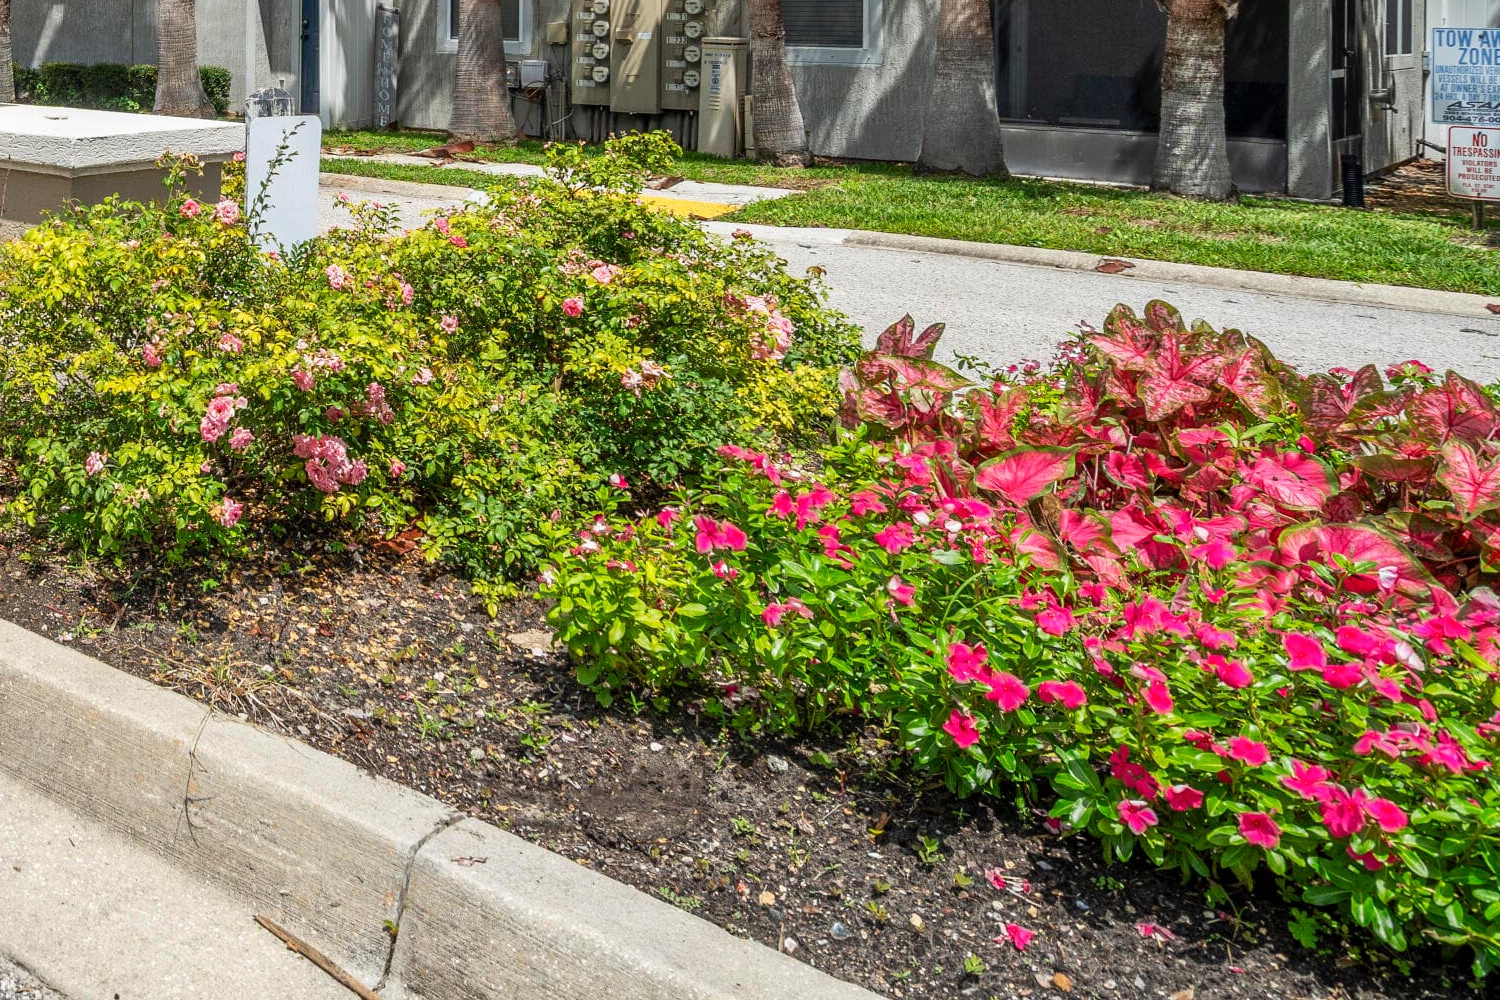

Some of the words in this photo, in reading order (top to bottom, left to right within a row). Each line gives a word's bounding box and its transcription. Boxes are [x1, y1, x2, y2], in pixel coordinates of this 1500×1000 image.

[1436, 29, 1473, 48] TOW
[1436, 65, 1483, 74] UNAUTHORIZED
[1438, 74, 1468, 84] VESSELS
[1470, 75, 1486, 84] WILL
[1489, 76, 1498, 85] BE
[1440, 83, 1448, 92] AT
[1450, 84, 1486, 93] OWNER'S
[1472, 132, 1488, 147] NO
